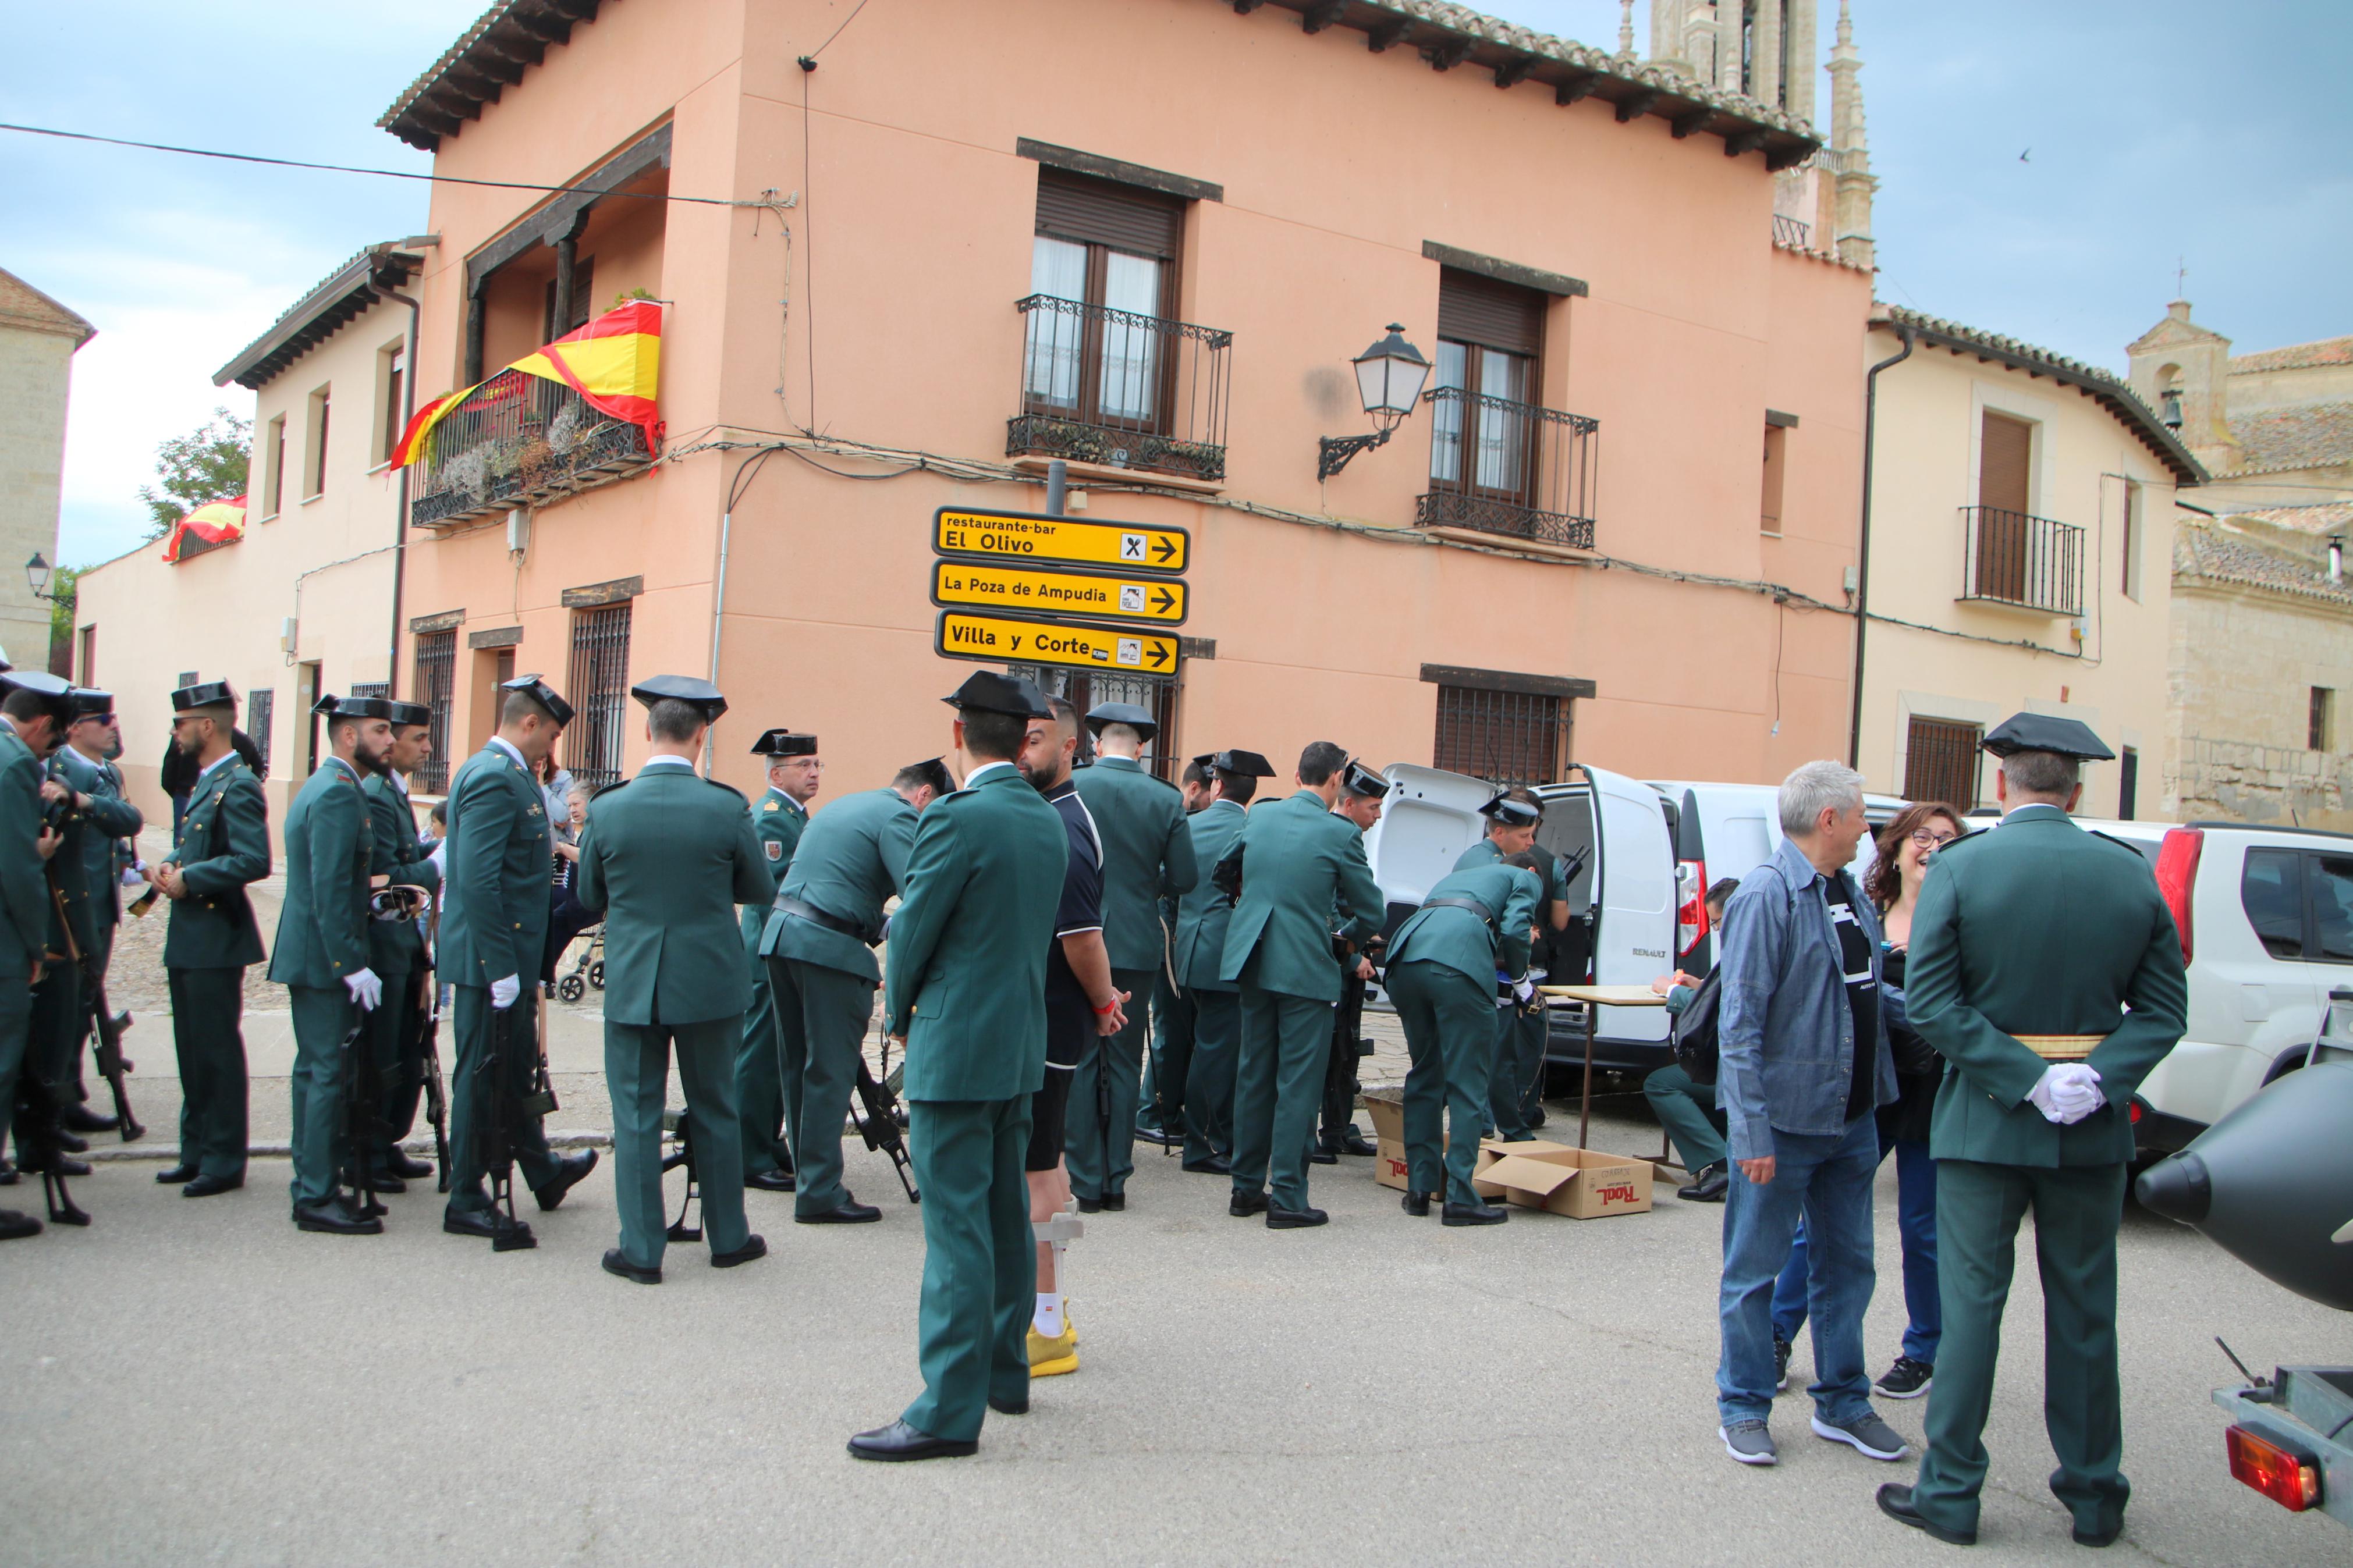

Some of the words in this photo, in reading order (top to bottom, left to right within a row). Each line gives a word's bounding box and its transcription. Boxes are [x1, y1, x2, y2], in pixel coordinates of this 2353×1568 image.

[947, 517, 1056, 535] restaurante-bar
[946, 531, 966, 547] El
[981, 534, 1034, 553] Olivo
[945, 576, 962, 590] La
[970, 578, 1005, 593] Poza
[1012, 582, 1031, 596] de
[1038, 584, 1106, 602] Ampudia
[952, 625, 996, 645] Villa
[1012, 635, 1021, 650] y
[1035, 634, 1089, 655] Corte
[1632, 948, 1666, 958] RENAULT
